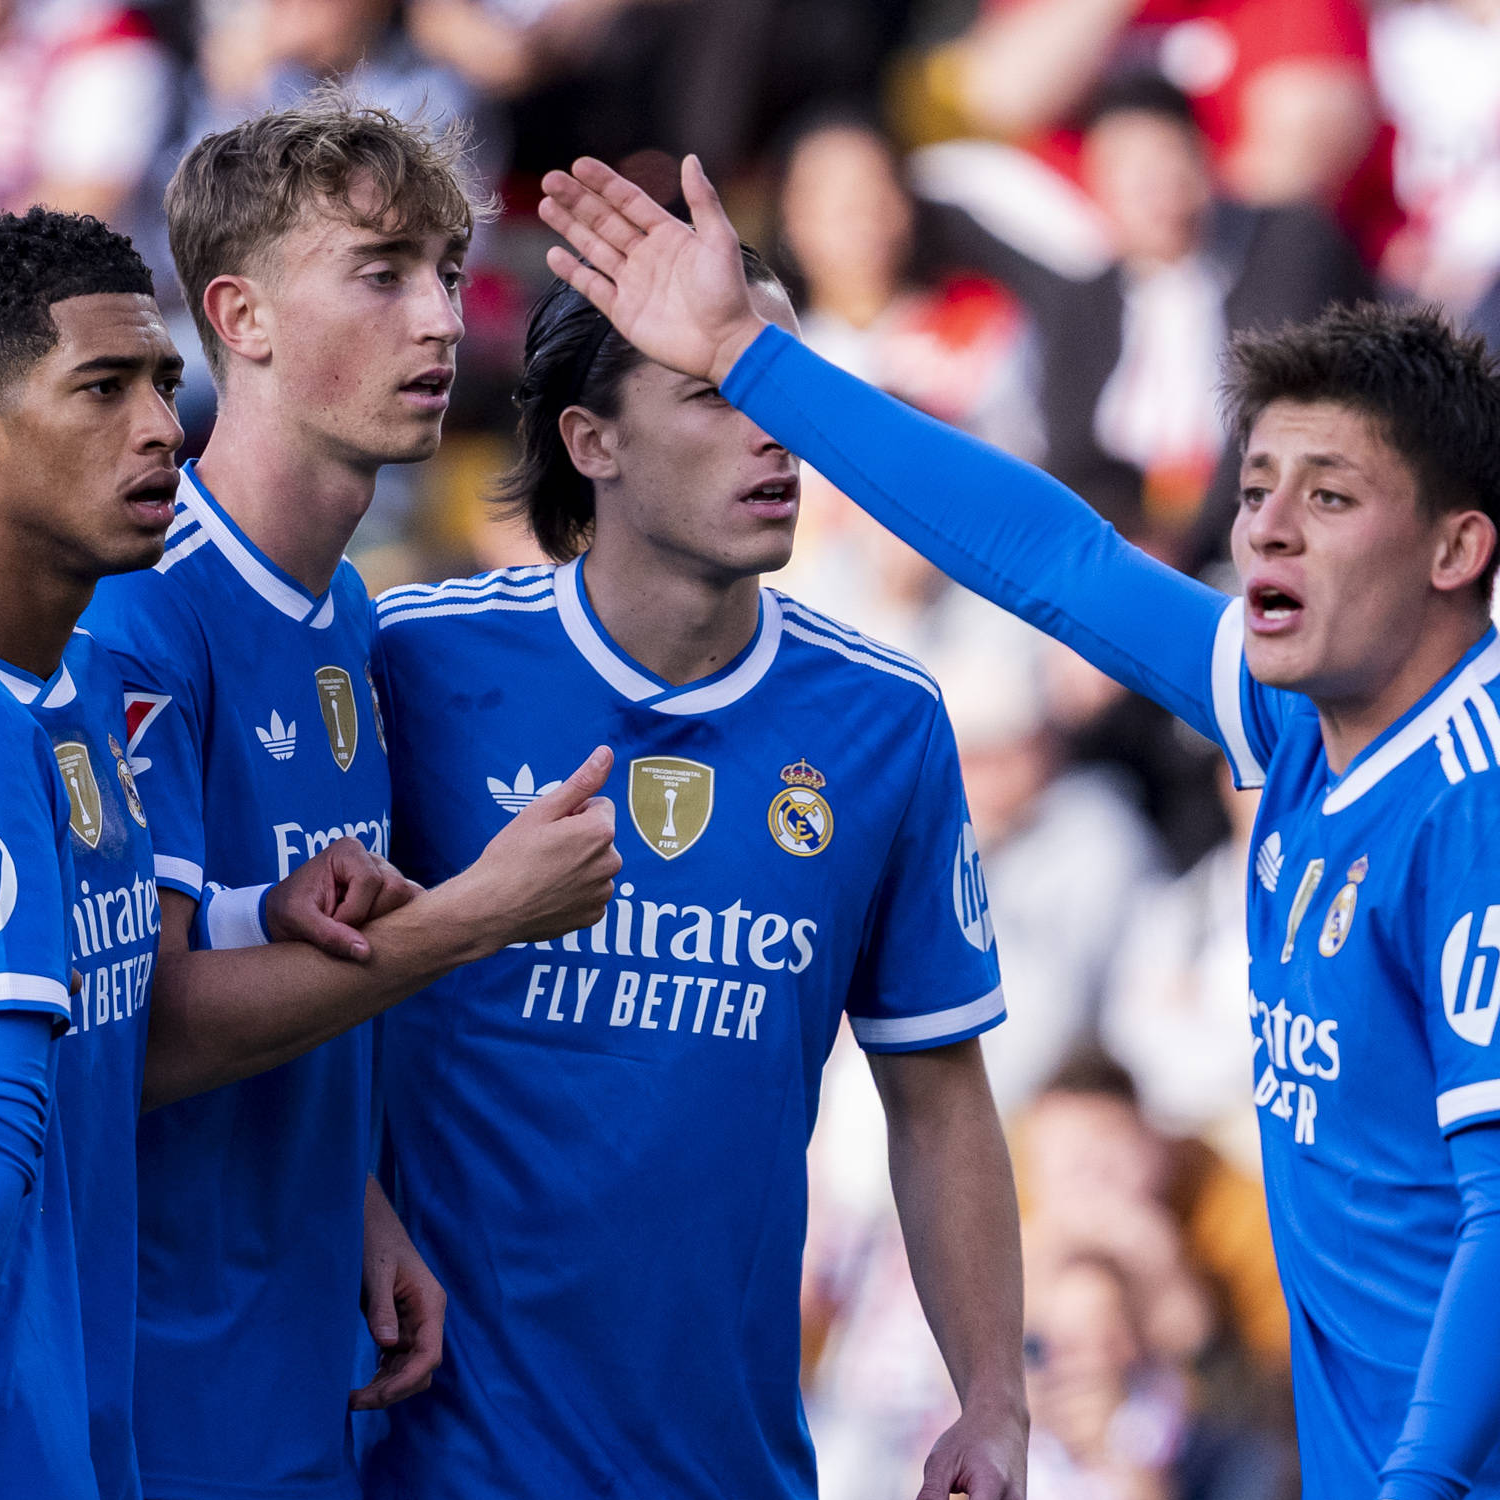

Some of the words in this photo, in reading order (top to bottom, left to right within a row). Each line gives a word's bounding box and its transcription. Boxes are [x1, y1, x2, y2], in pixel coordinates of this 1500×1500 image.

[658, 840, 679, 849] FIFA
[506, 882, 817, 974] irates
[522, 964, 600, 1023] FLY
[609, 970, 766, 1040] BETTER
